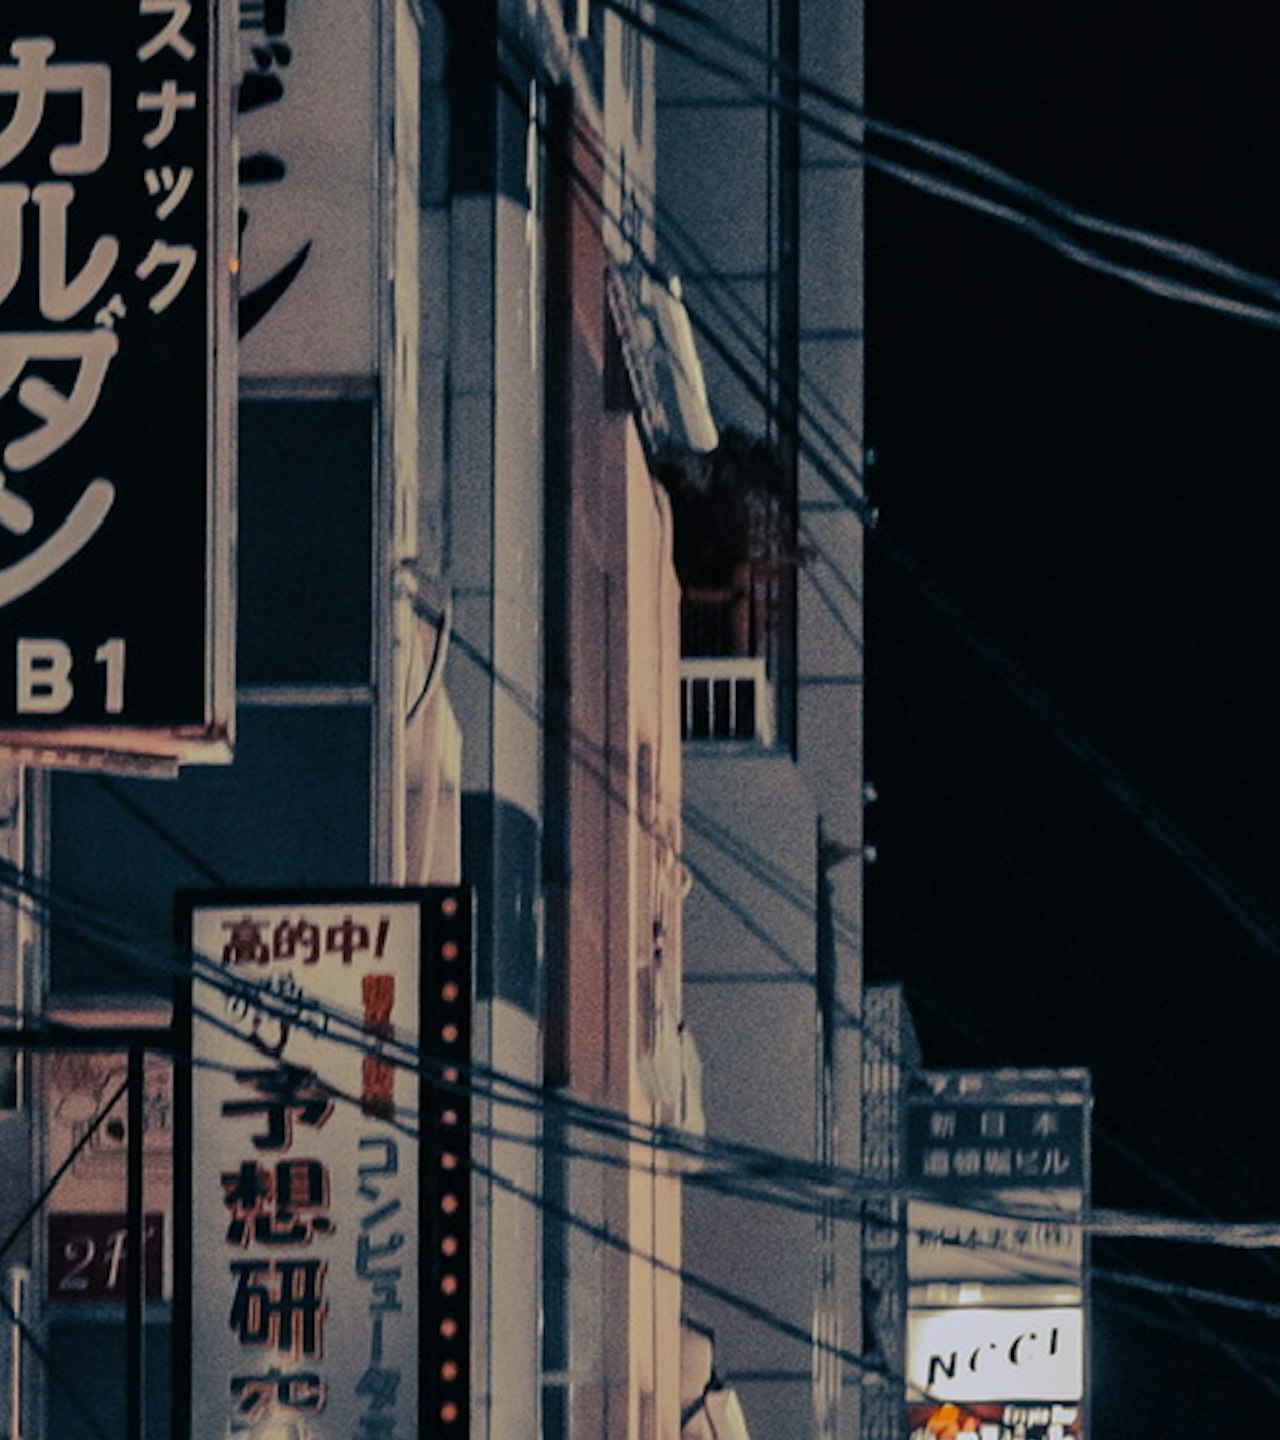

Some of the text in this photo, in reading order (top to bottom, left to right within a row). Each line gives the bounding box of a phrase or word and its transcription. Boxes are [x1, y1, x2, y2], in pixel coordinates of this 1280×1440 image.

[134, 0, 197, 313] スナック
[15, 636, 126, 714] B1
